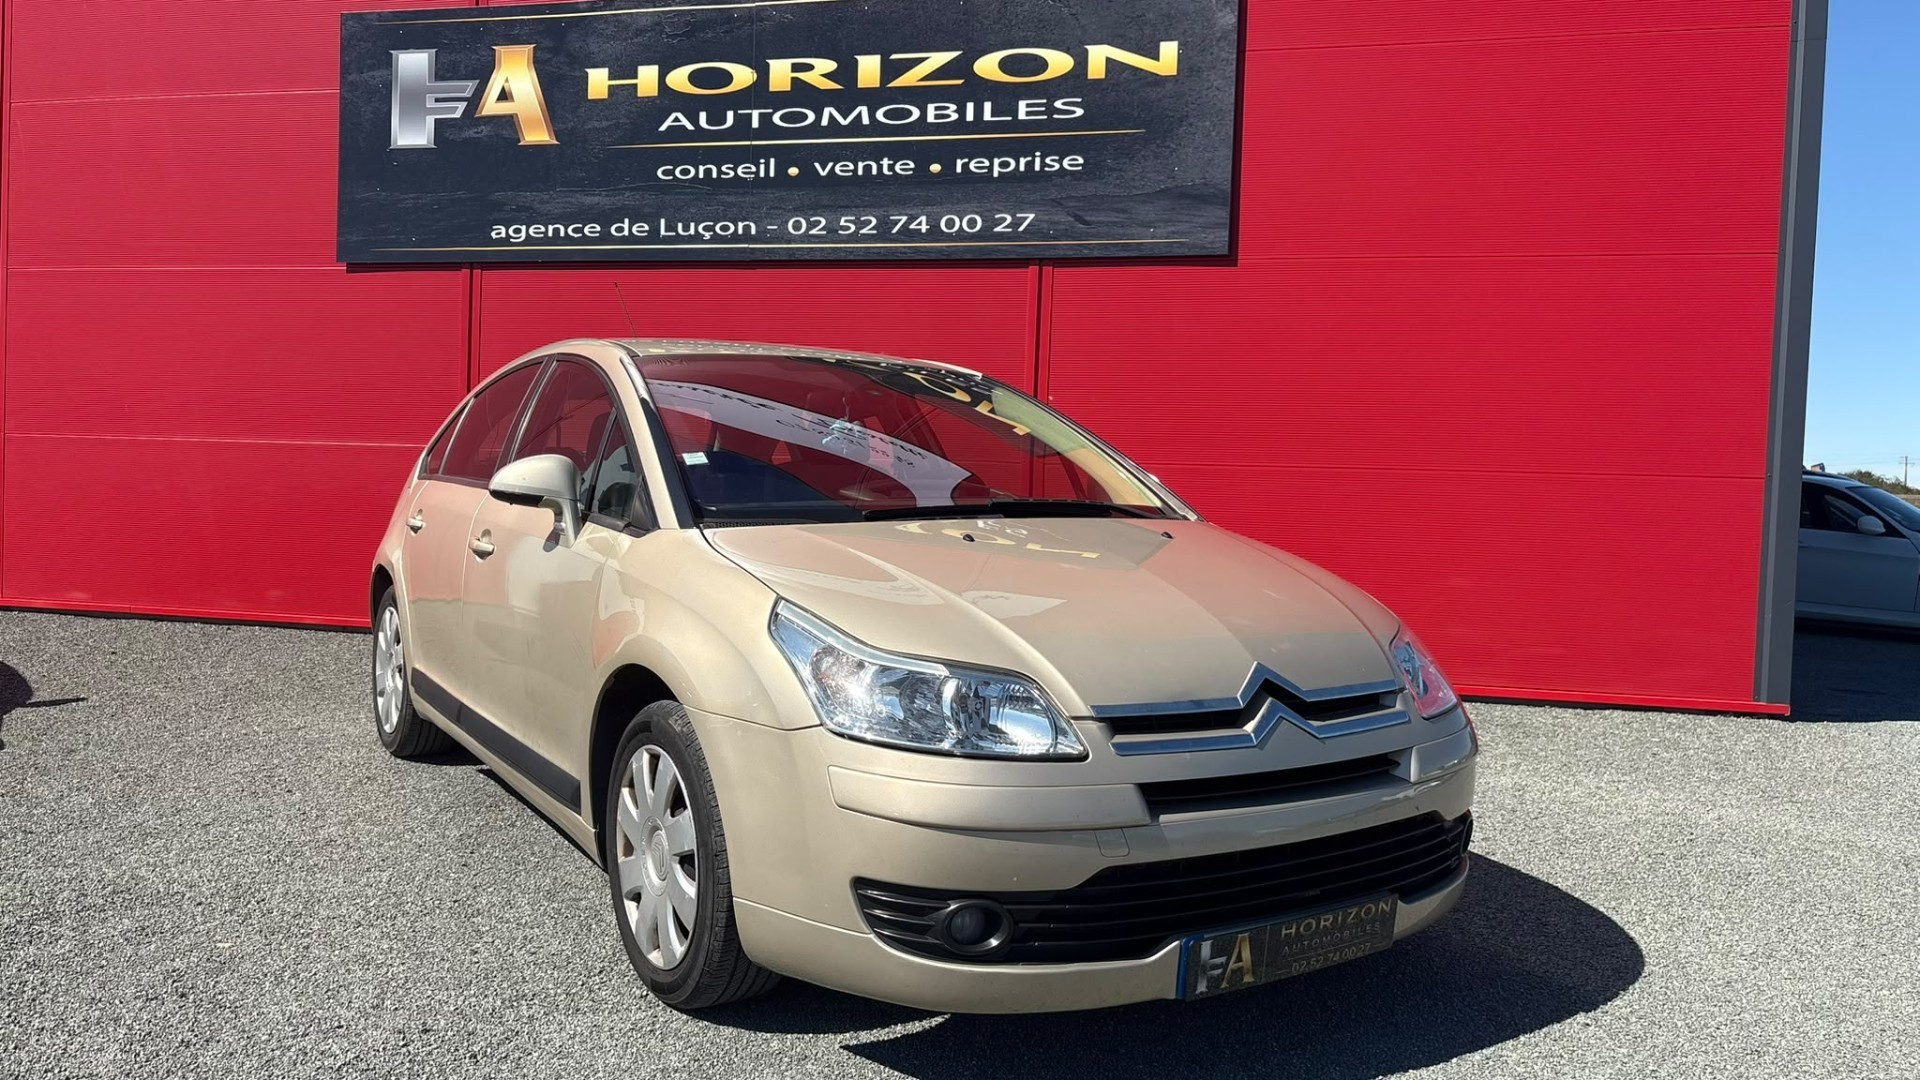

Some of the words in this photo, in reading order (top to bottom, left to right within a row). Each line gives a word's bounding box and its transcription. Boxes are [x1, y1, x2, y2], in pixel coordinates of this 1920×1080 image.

[585, 41, 1179, 100] HORIZON
[658, 98, 1086, 132] AUTOMOBILES
[656, 158, 776, 181] conseil
[813, 155, 916, 177] vente
[955, 151, 1085, 178] reprise
[490, 223, 602, 243] agence
[610, 217, 650, 237] de
[659, 217, 757, 240] Luçon
[787, 216, 828, 235] 02
[837, 215, 878, 235] 52
[889, 215, 931, 234] 74
[939, 214, 983, 233] 00
[992, 213, 1036, 232] 27
[1281, 899, 1392, 939] HORIZON
[1282, 921, 1382, 955] AUTOMOBILES
[1291, 960, 1307, 973] 02
[1327, 951, 1341, 963] 74
[1342, 946, 1357, 958] 00
[1359, 942, 1372, 954] 27
